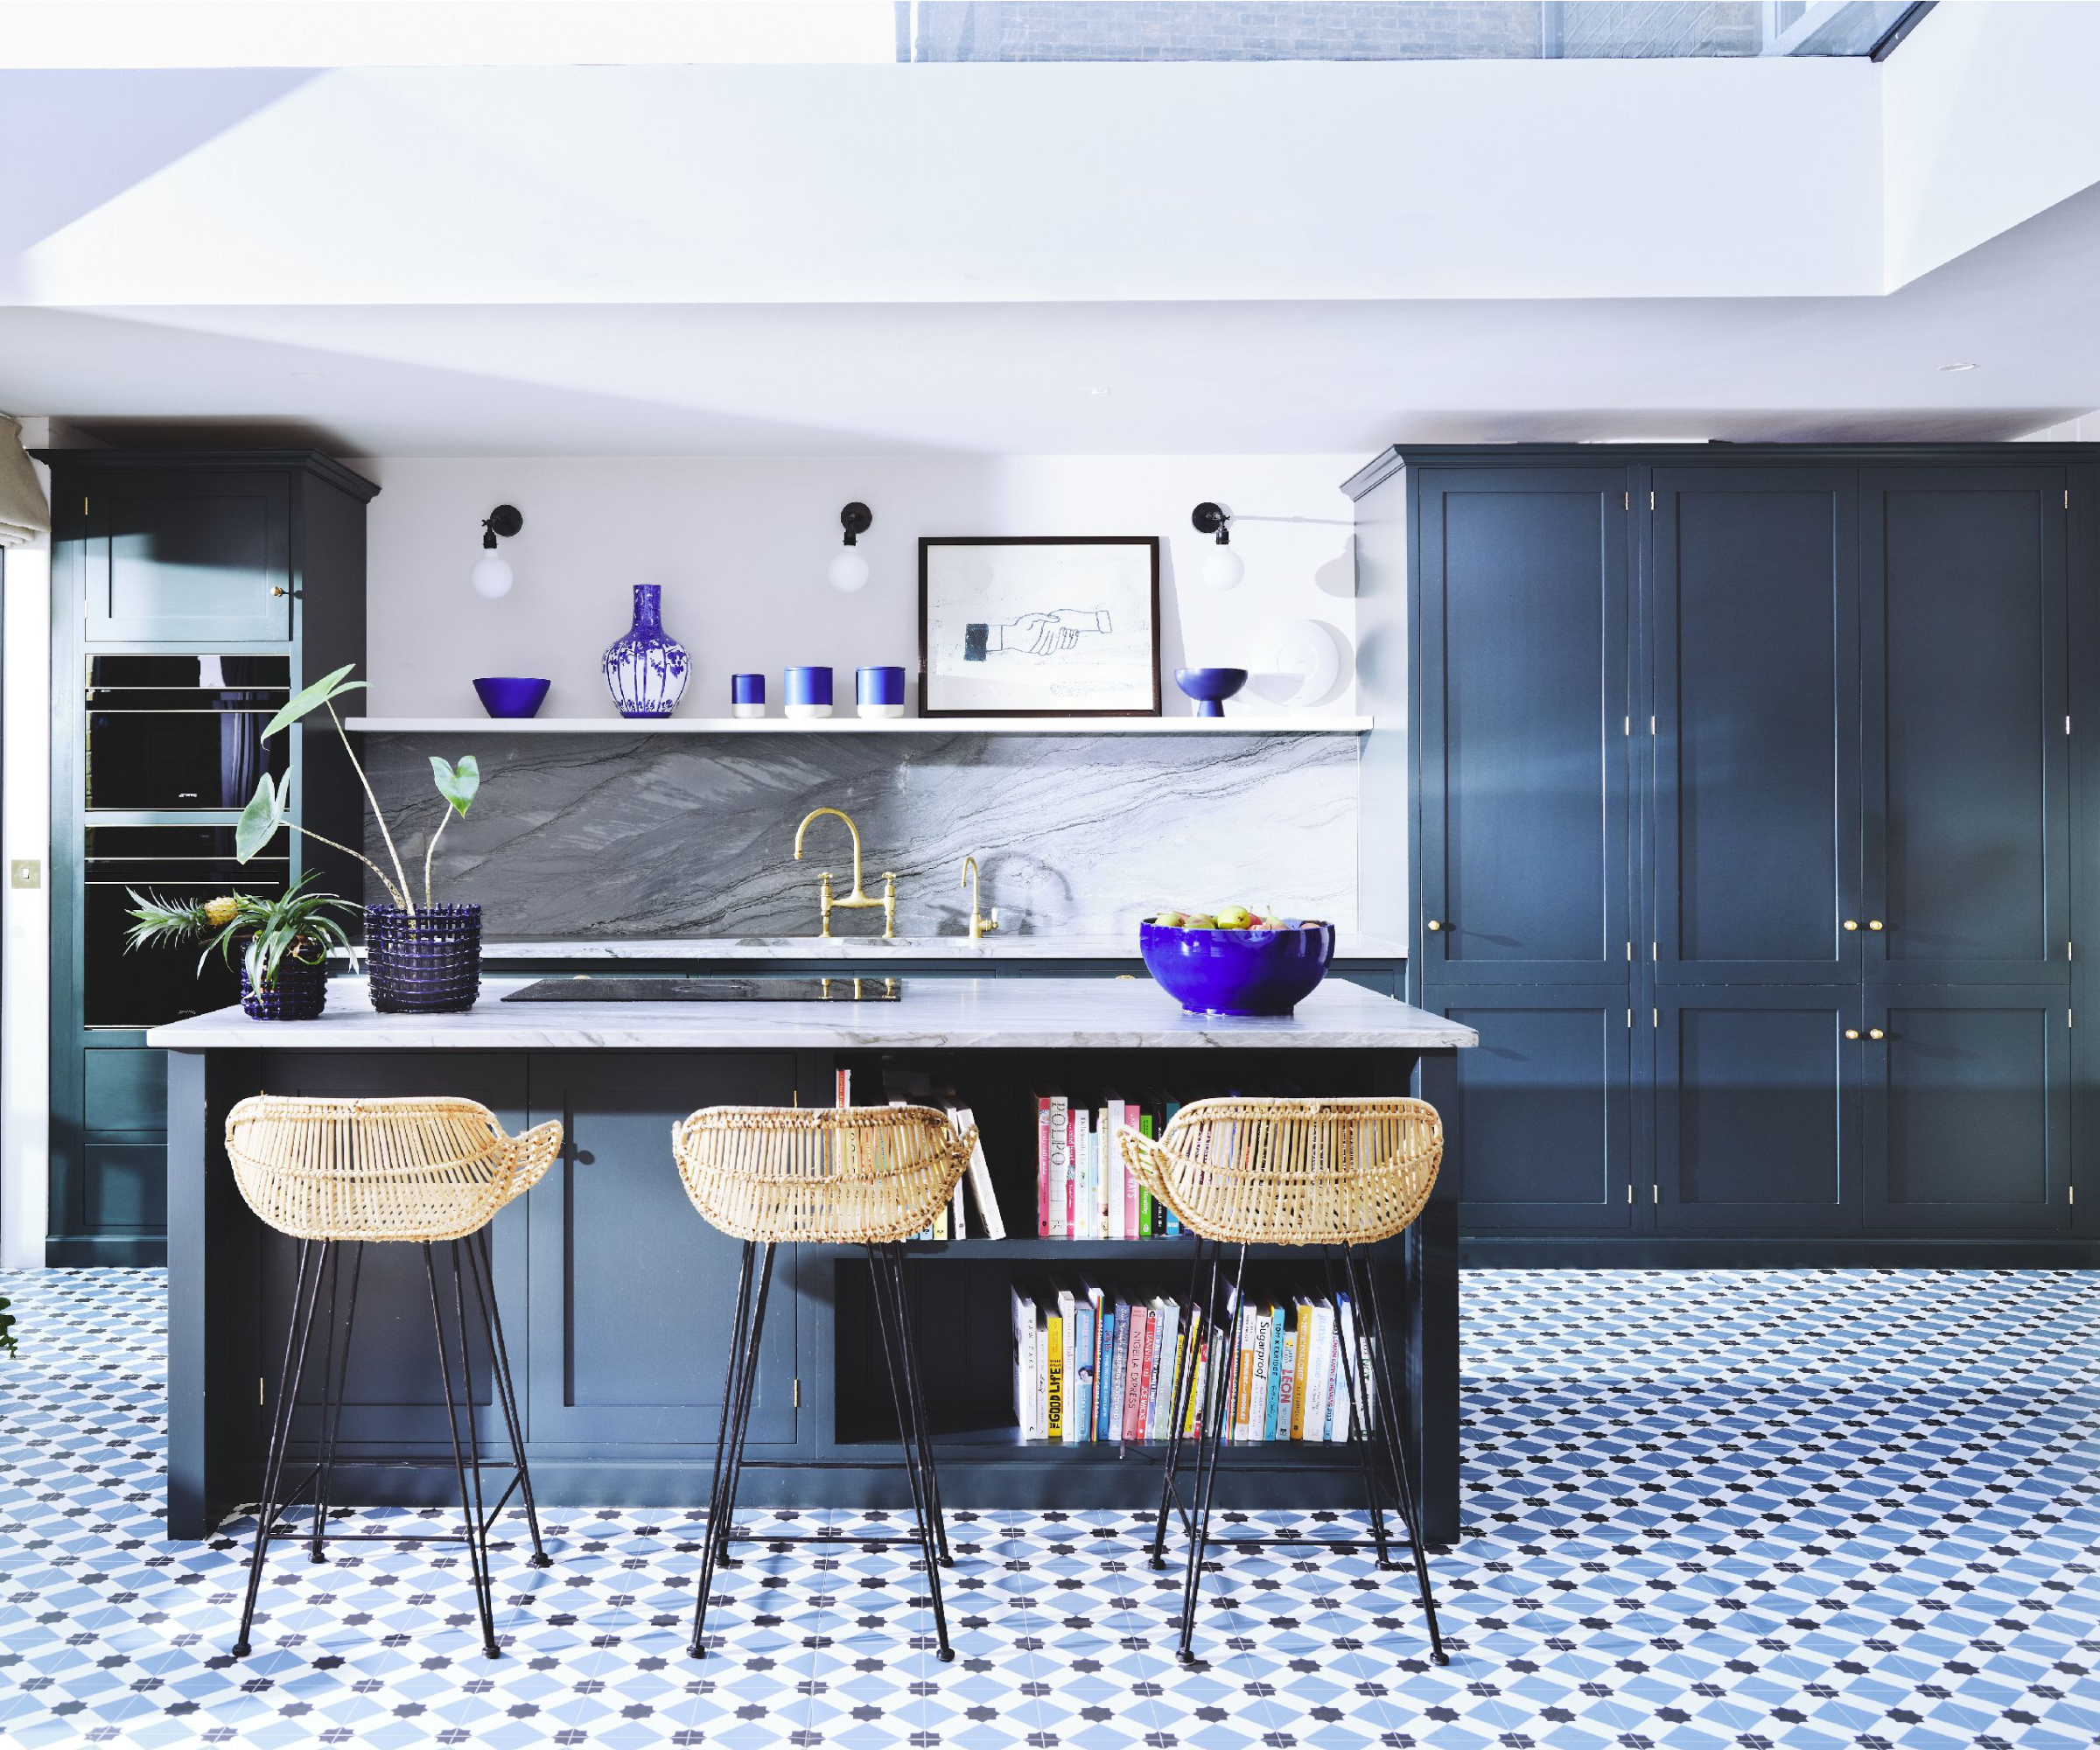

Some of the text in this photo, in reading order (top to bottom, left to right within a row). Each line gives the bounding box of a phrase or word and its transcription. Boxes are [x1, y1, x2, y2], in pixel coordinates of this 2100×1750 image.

[1051, 1102, 1066, 1166] POLPO
[1127, 1178, 1137, 1199] WAYS
[1254, 1321, 1270, 1381] Sugarproof
[1298, 1321, 1308, 1362] MEDICINAL
[1128, 1331, 1141, 1409] NIGELLA EXPRESS
[1271, 1340, 1281, 1376] KERRIDGE
[1297, 1362, 1306, 1381] CHEF
[1314, 1353, 1326, 1378] home
[1140, 1385, 1150, 1398] JOE
[1280, 1369, 1293, 1404] LEON
[1049, 1395, 1061, 1422] GOOD
[1138, 1398, 1148, 1421] WICKS
